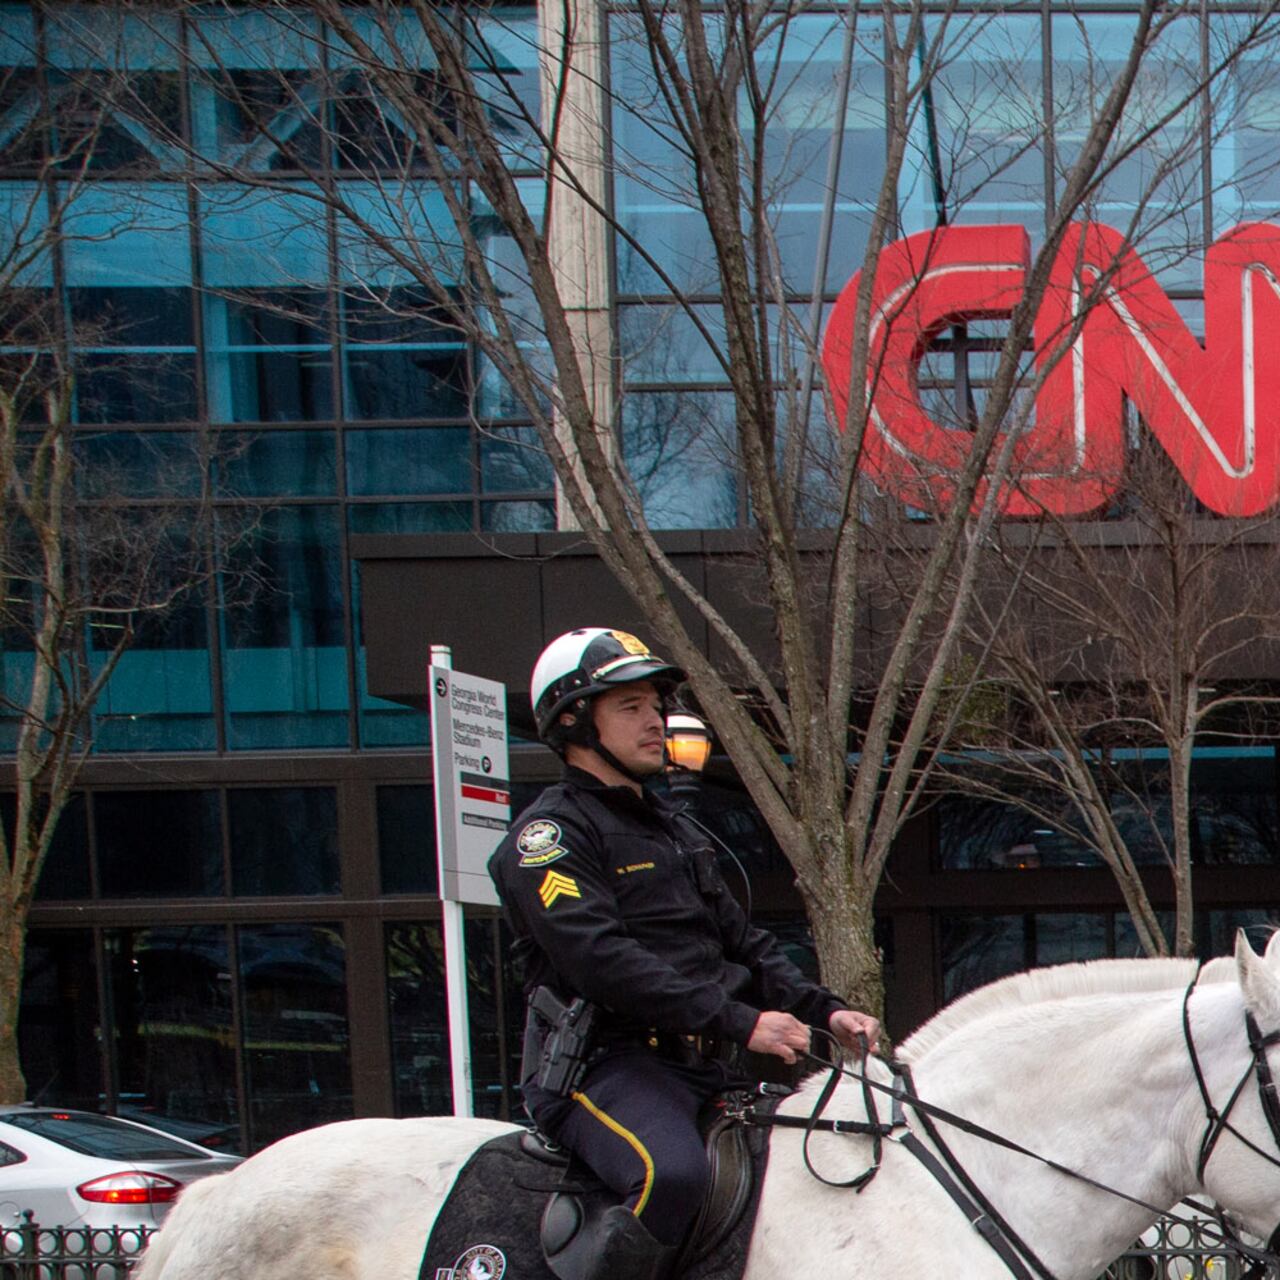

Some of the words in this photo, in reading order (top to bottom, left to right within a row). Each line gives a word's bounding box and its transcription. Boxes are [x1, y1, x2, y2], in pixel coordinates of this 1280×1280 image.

[452, 684, 477, 703] Georgia
[477, 689, 497, 707] World
[452, 697, 482, 716] Congress
[484, 704, 504, 721] Center
[453, 718, 504, 741] Mercedes-Benz
[453, 731, 481, 748] Stadium
[454, 751, 480, 771] Parking
